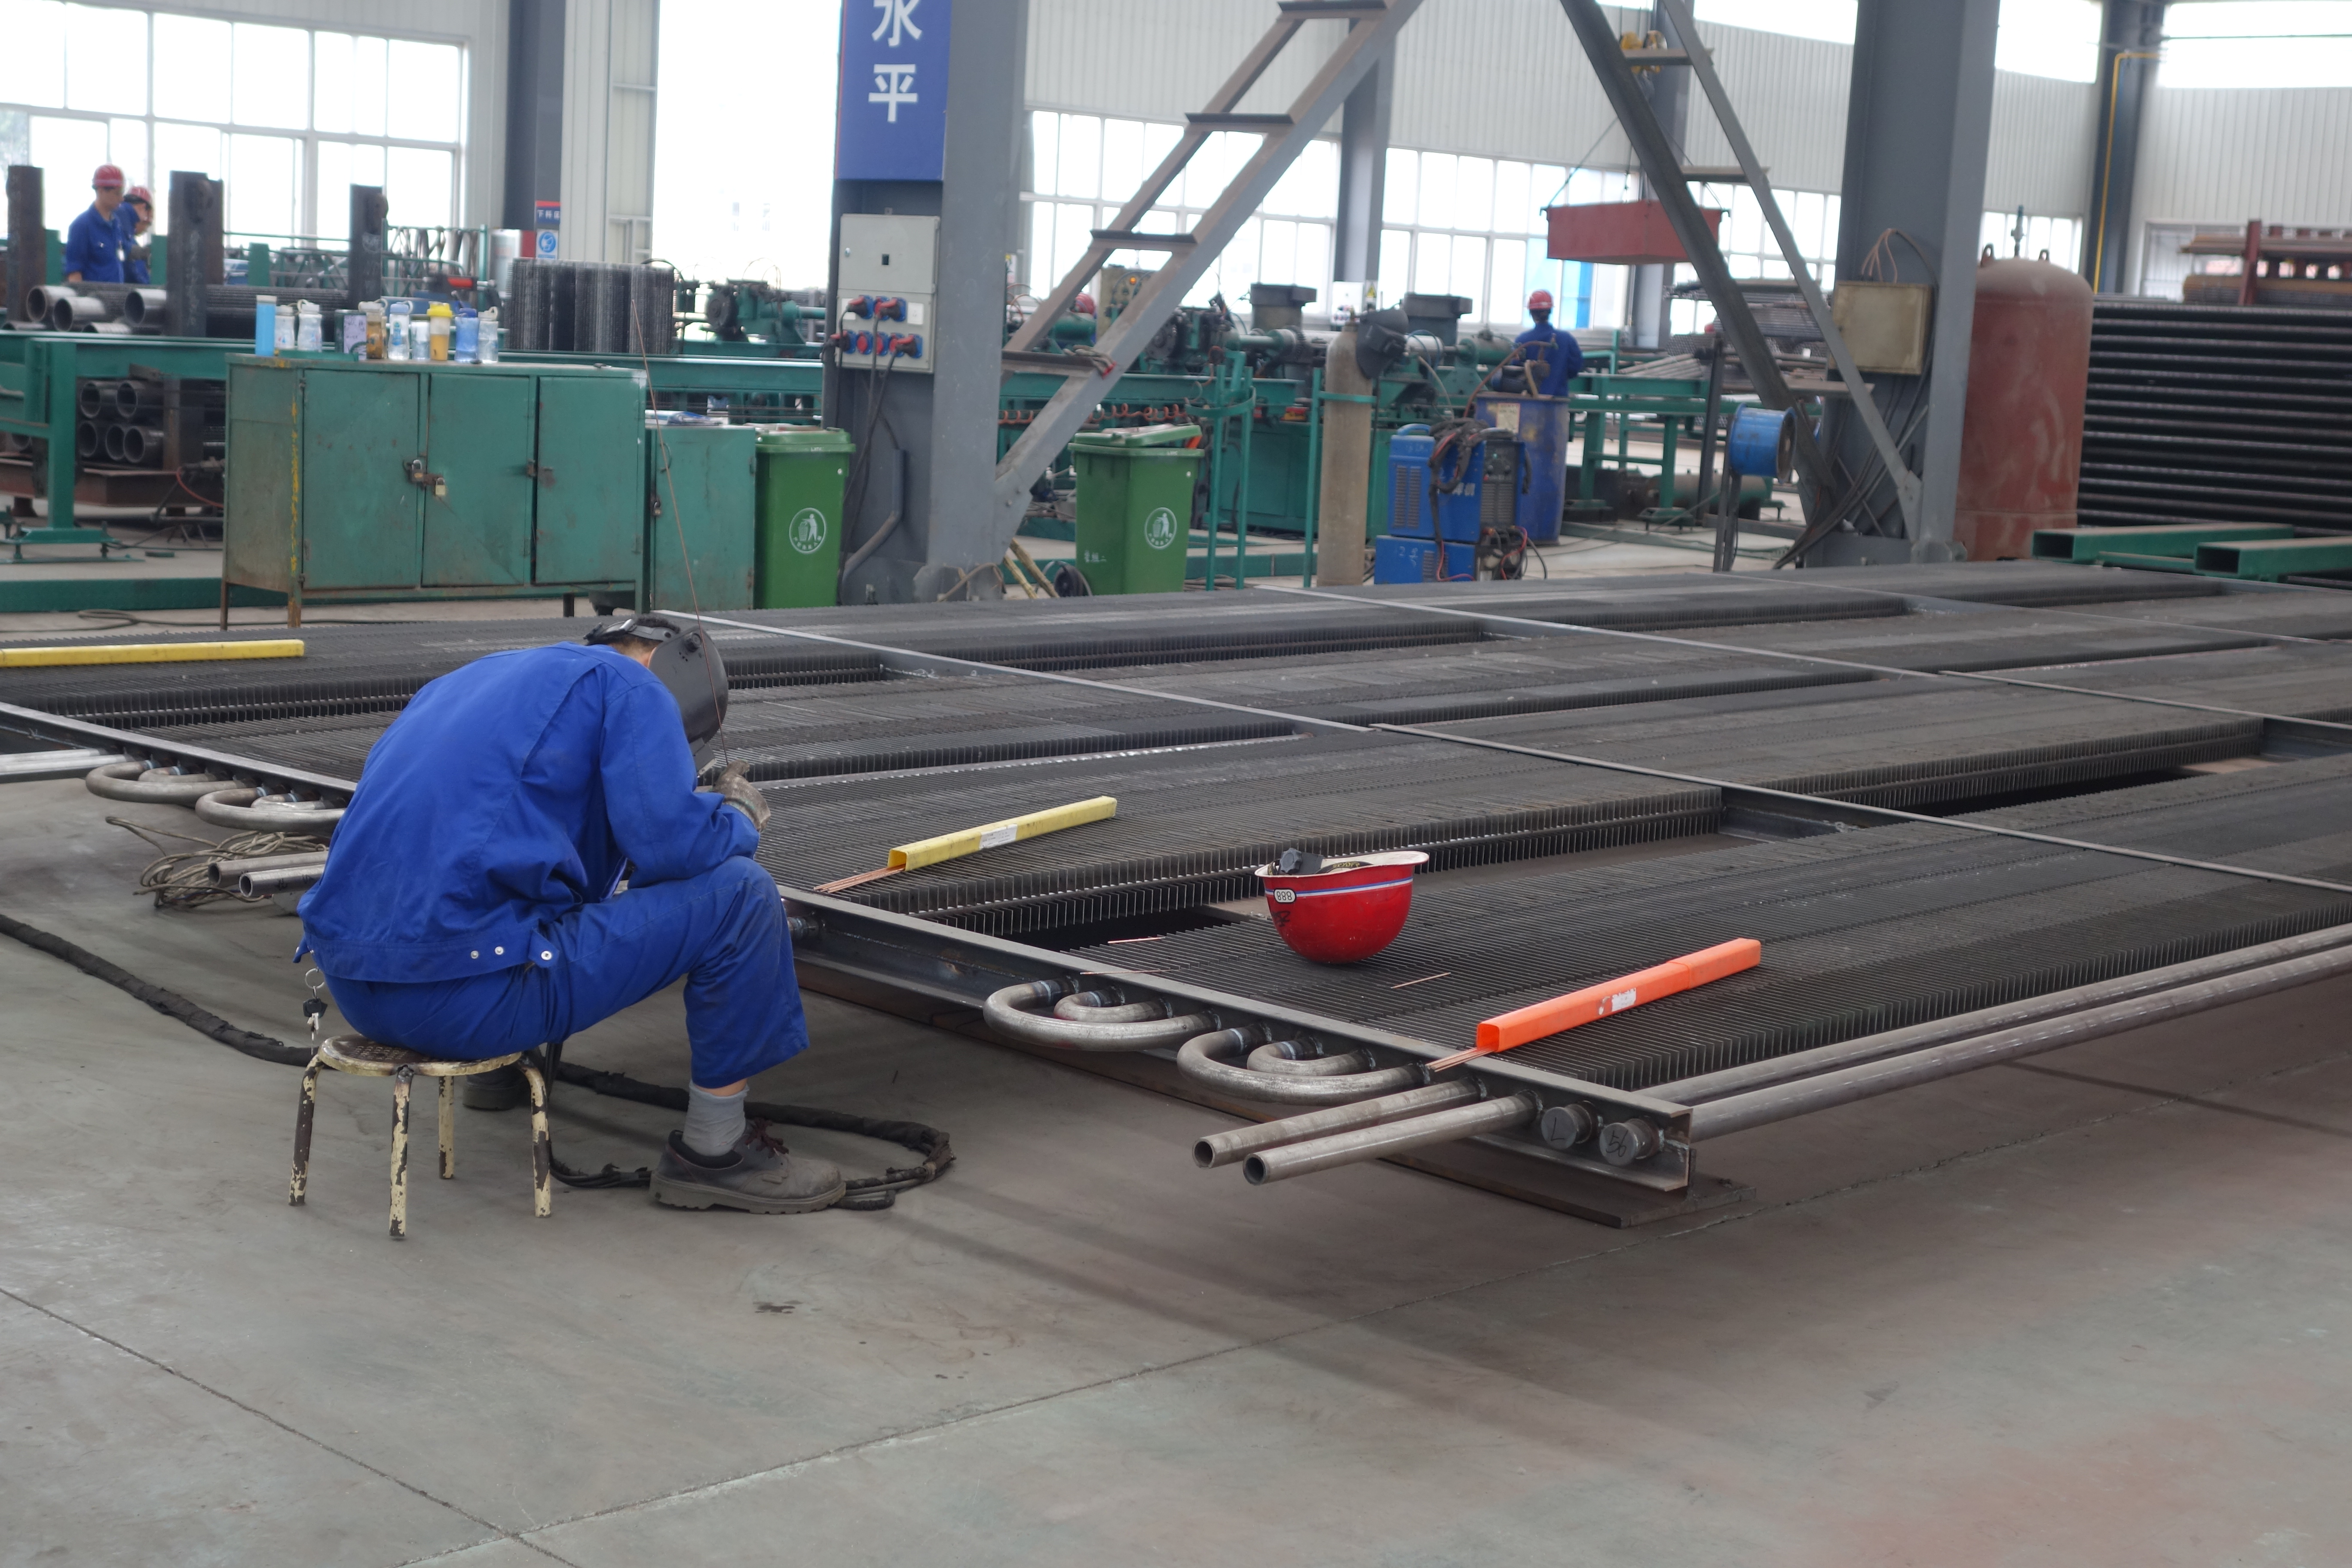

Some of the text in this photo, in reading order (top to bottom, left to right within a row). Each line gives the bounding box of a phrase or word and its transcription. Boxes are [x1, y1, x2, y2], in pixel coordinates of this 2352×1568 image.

[868, 0, 923, 122] 水平
[1276, 891, 1292, 900] 888
[1605, 1129, 1629, 1158] 56
